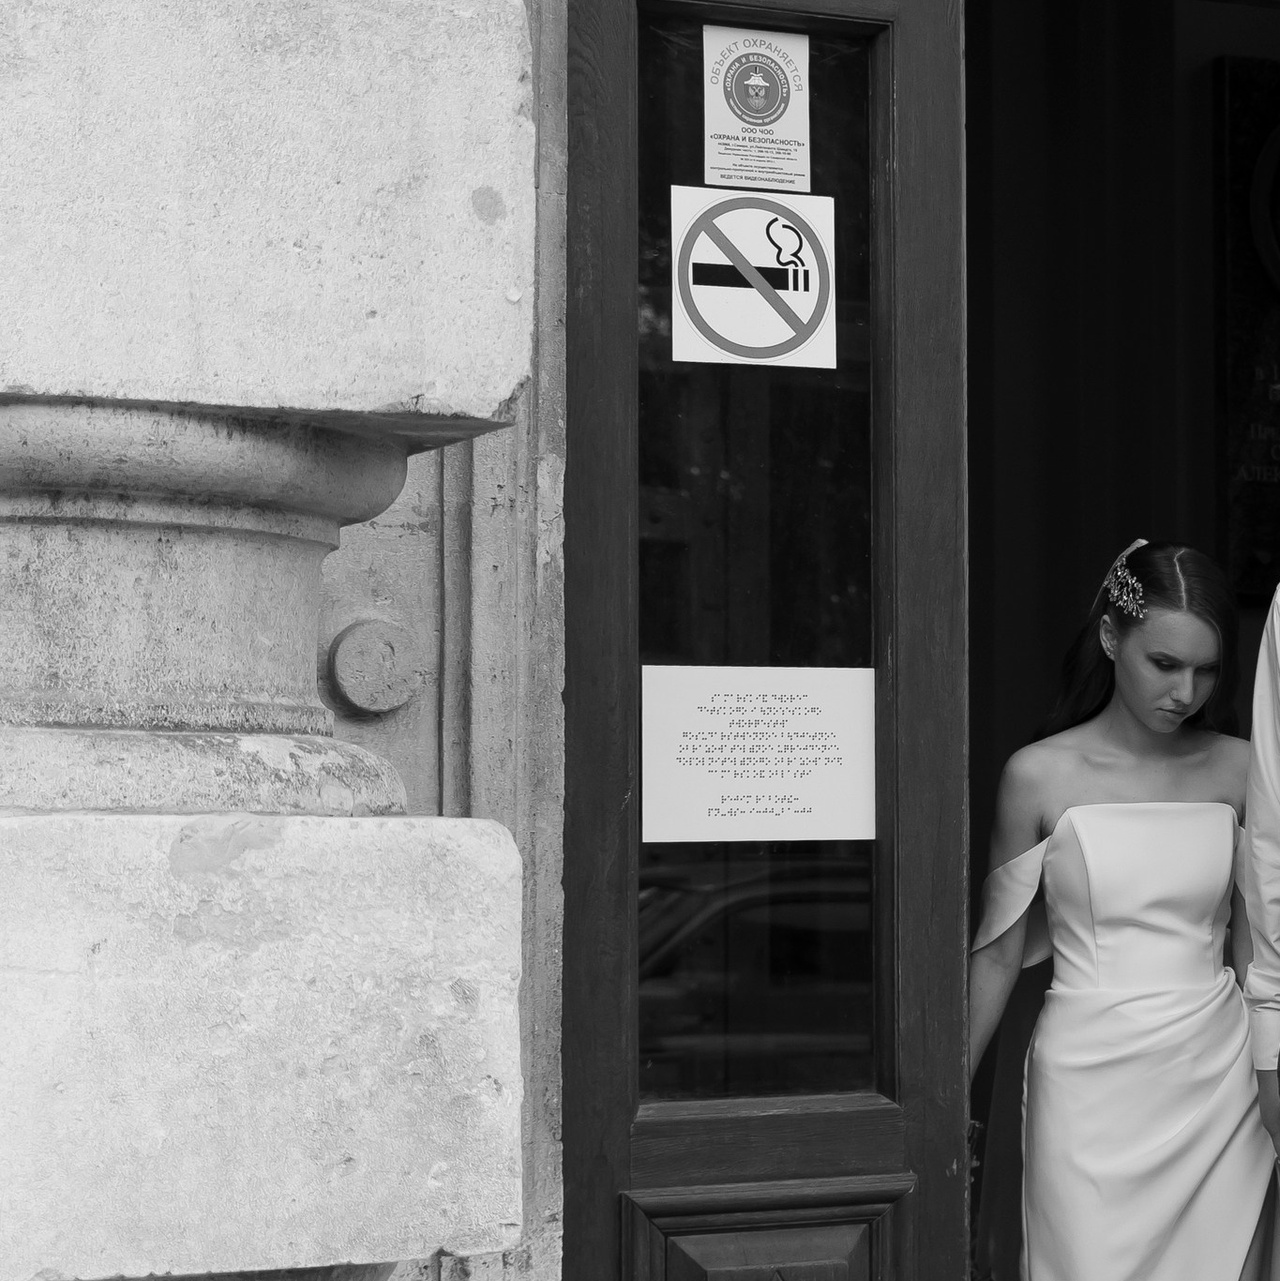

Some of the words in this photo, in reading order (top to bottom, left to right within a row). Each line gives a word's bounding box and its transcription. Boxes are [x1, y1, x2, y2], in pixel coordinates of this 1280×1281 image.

[710, 40, 739, 85] ОБЪЕКТ
[743, 38, 804, 92] ОХРАНЯЕТСЯ
[741, 126, 757, 134] ООО
[758, 128, 774, 136] ЧОО
